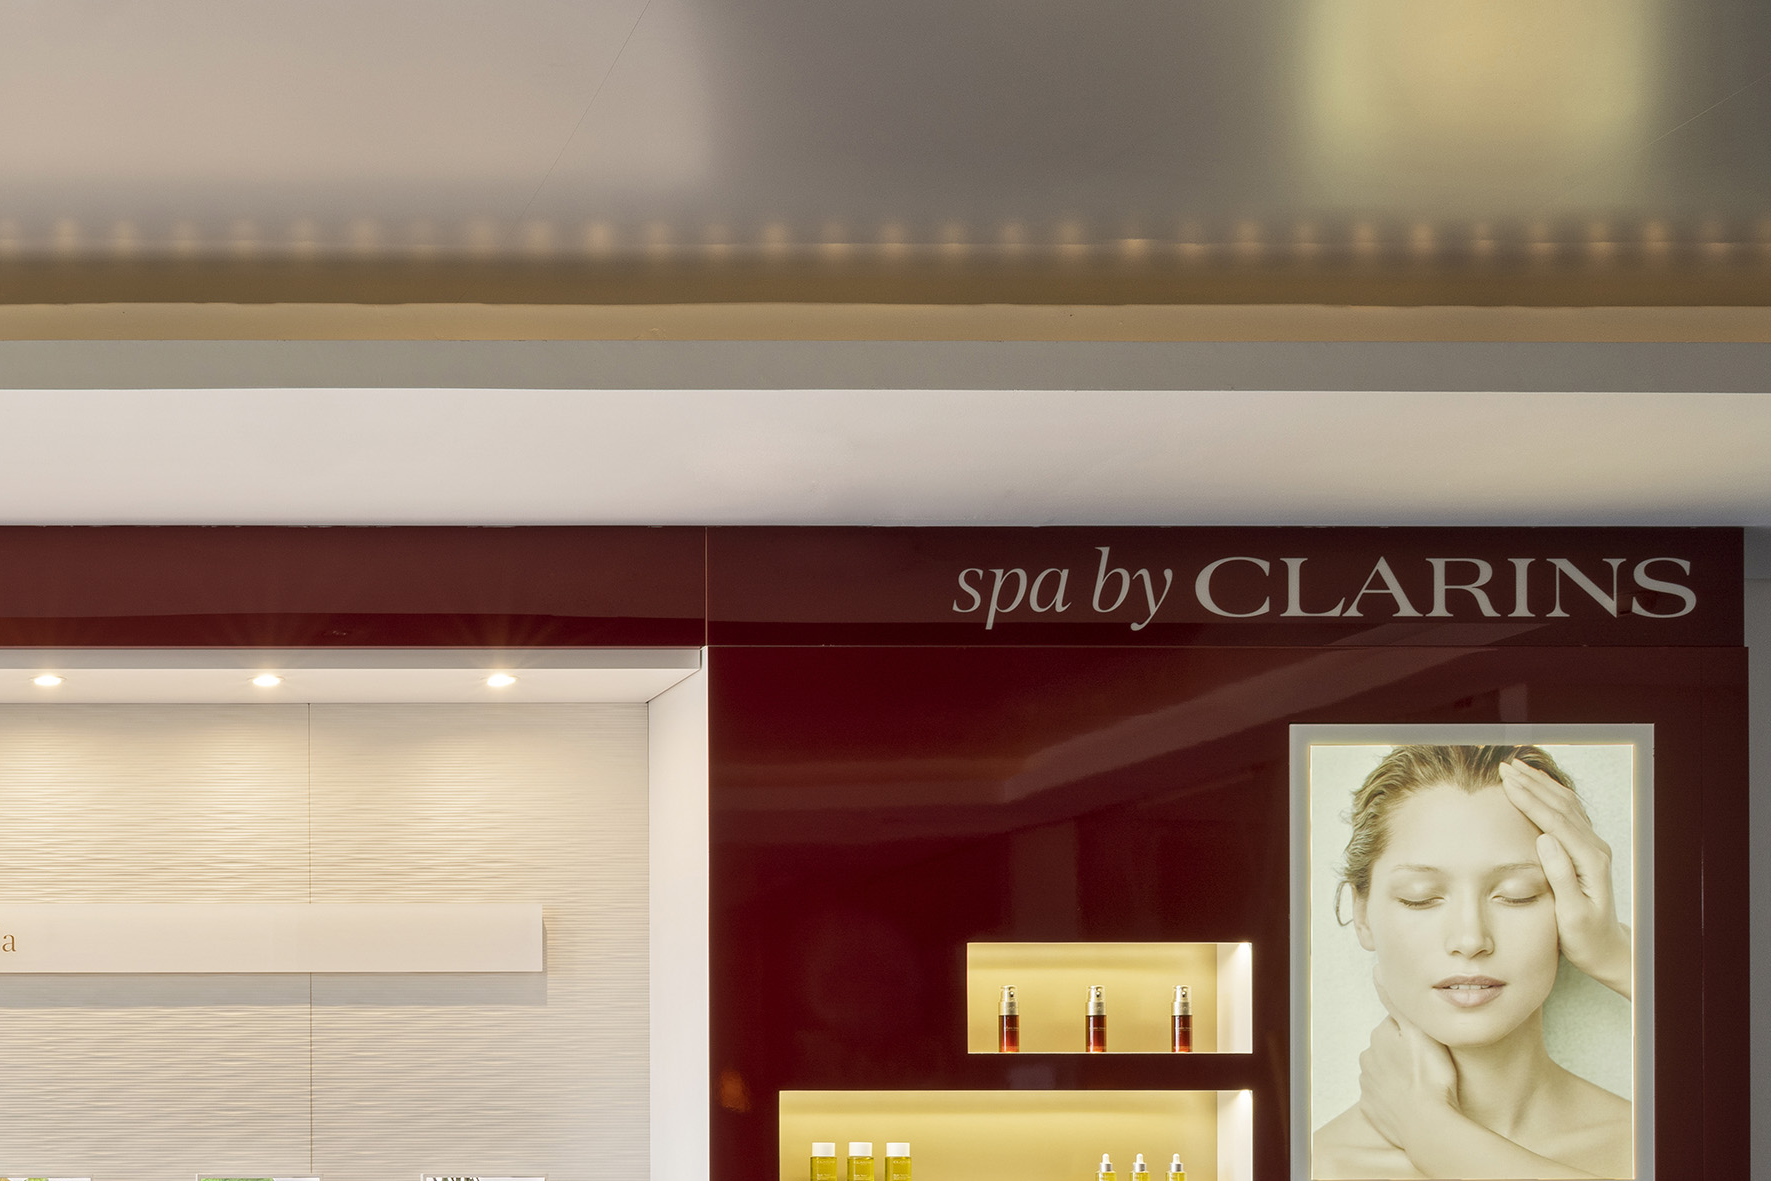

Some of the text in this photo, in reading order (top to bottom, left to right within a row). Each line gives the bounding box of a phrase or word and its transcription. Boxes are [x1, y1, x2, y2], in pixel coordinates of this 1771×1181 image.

[952, 546, 1698, 631] spa by CLARINS
